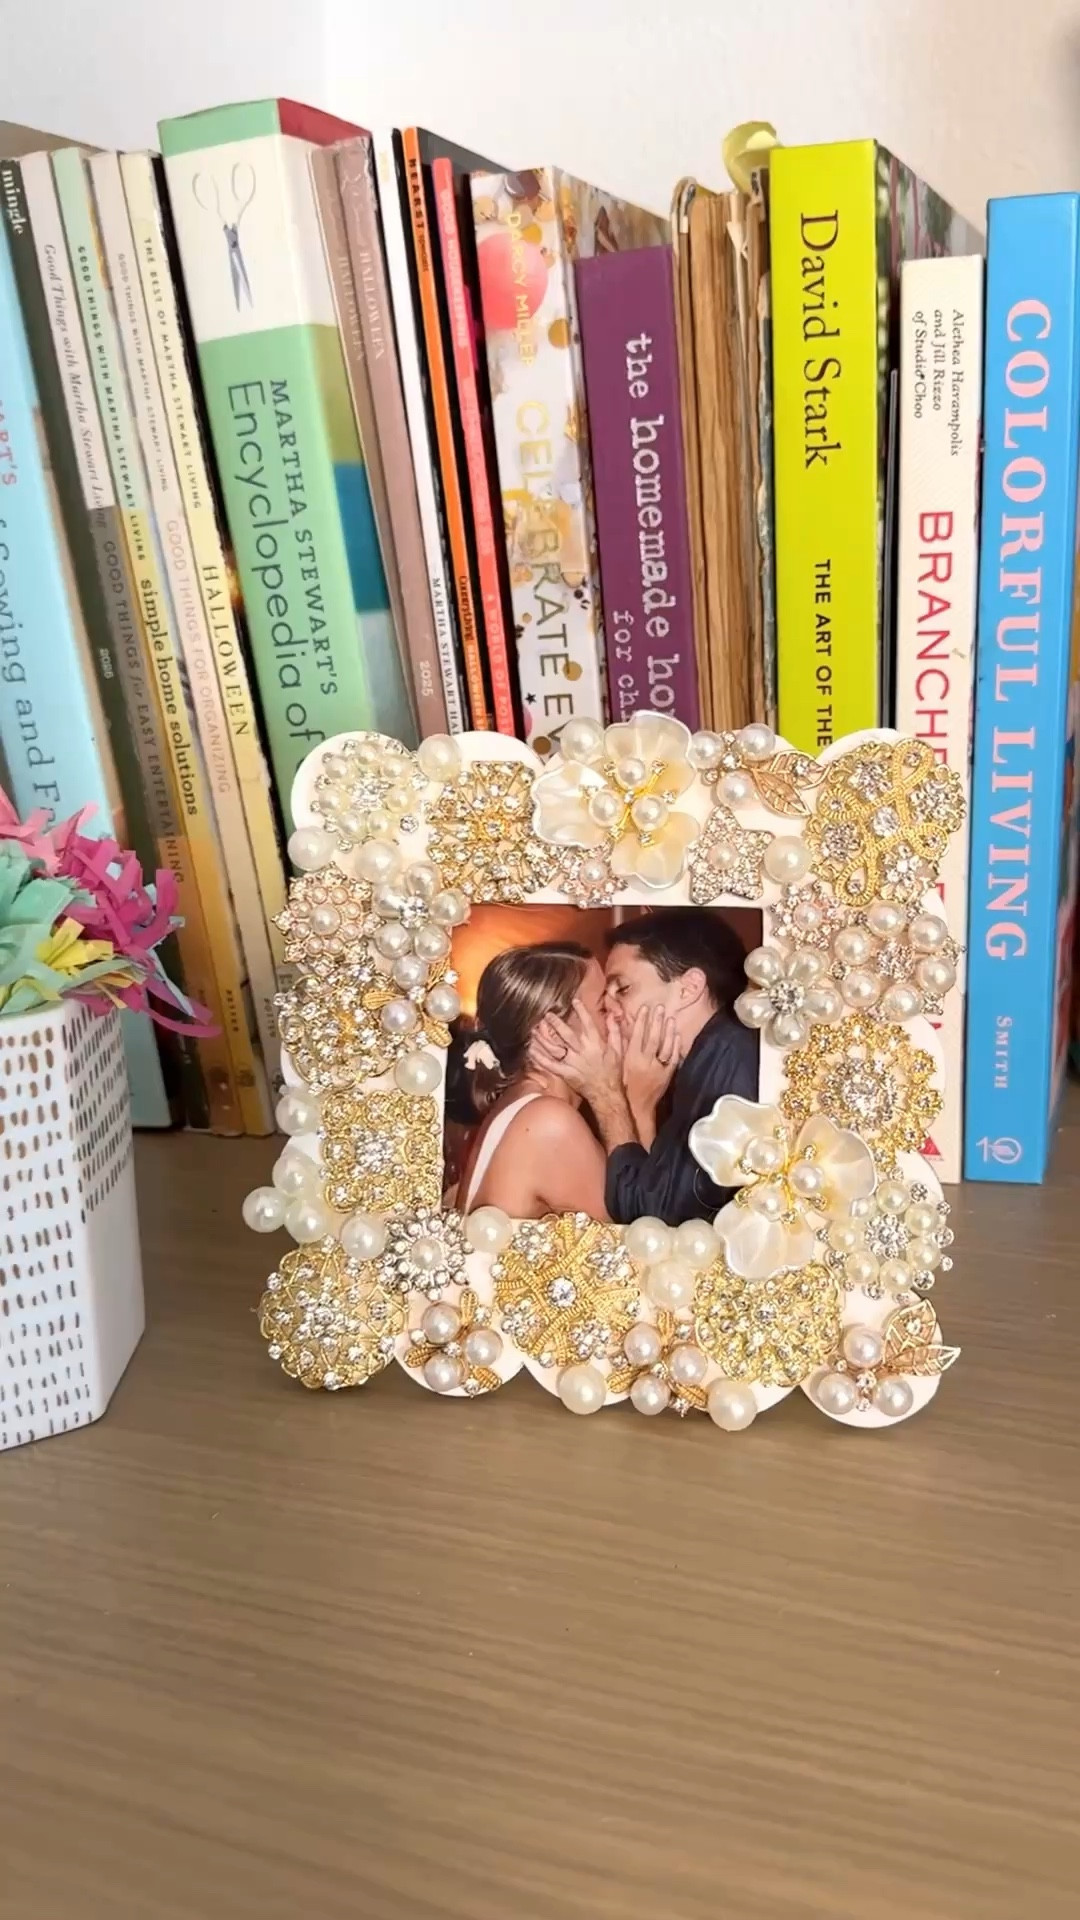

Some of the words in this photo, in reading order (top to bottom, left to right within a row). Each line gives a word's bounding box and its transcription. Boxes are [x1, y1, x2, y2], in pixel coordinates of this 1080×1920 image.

[2, 169, 27, 234] mingle
[408, 158, 425, 230] HEARST
[43, 244, 61, 282] Good
[117, 253, 130, 283] GOOD
[143, 238, 154, 263] THE
[505, 211, 526, 287] DARCY
[149, 271, 162, 304] BEST
[799, 210, 840, 342] David
[49, 285, 71, 332] Things
[123, 285, 138, 324] THINGS
[157, 310, 168, 327] OF
[515, 294, 534, 367] MILLER
[912, 310, 928, 327] of
[933, 309, 946, 338] and
[62, 336, 78, 368] with
[131, 328, 142, 355] WITH
[160, 334, 179, 391] MARTHA
[914, 328, 927, 378] Studio
[931, 341, 946, 364] Jill
[952, 309, 965, 365] Alethea
[137, 358, 152, 401] MARTHA
[625, 333, 654, 399] the
[933, 368, 946, 411] Rizzo
[66, 371, 89, 424] Martha
[77, 245, 91, 283] GOOD
[84, 288, 102, 339] THINGS
[96, 345, 111, 380] WITH
[104, 386, 122, 441] MARTHA
[116, 448, 136, 509] STEWART
[129, 515, 147, 562] LIVING
[803, 356, 842, 470] Stark
[914, 382, 927, 419] Choo
[948, 370, 965, 457] Harampolis
[145, 406, 162, 453] STEWART
[172, 397, 192, 458] STEWART
[78, 427, 100, 482] Stewart
[156, 458, 169, 492] LIVING
[88, 485, 111, 530] Living
[184, 464, 202, 510] LIVING
[993, 300, 1052, 701] COLORFUL
[165, 519, 188, 570] GOOD
[269, 380, 308, 518] MARTHA
[293, 529, 338, 696] STEWART'S
[514, 401, 572, 677] CELEBRATE
[628, 416, 677, 639] homemade
[103, 541, 126, 595] GOOD
[227, 381, 309, 690] Encyclopedia
[286, 703, 326, 742] of
[815, 560, 832, 604] THE
[115, 599, 142, 669] THINGS
[138, 578, 168, 652] simple
[177, 576, 204, 644] THINGS
[613, 610, 636, 662] for
[815, 612, 832, 658] ART
[201, 564, 251, 737] HALLOWEEN
[432, 578, 447, 637] MARTHA
[440, 642, 456, 707] STEWART
[489, 609, 503, 664] WORLD
[127, 673, 146, 698] for
[152, 656, 180, 717] home
[190, 648, 210, 681] FOR
[420, 660, 434, 696] 2025
[495, 670, 507, 689] OF
[815, 666, 833, 698] OF
[16, 699, 55, 768] and
[137, 704, 157, 747] EASY
[198, 687, 231, 794] ORGANIZING
[816, 705, 833, 747] THE
[168, 721, 200, 816] solutions
[985, 726, 1035, 960] LIVING
